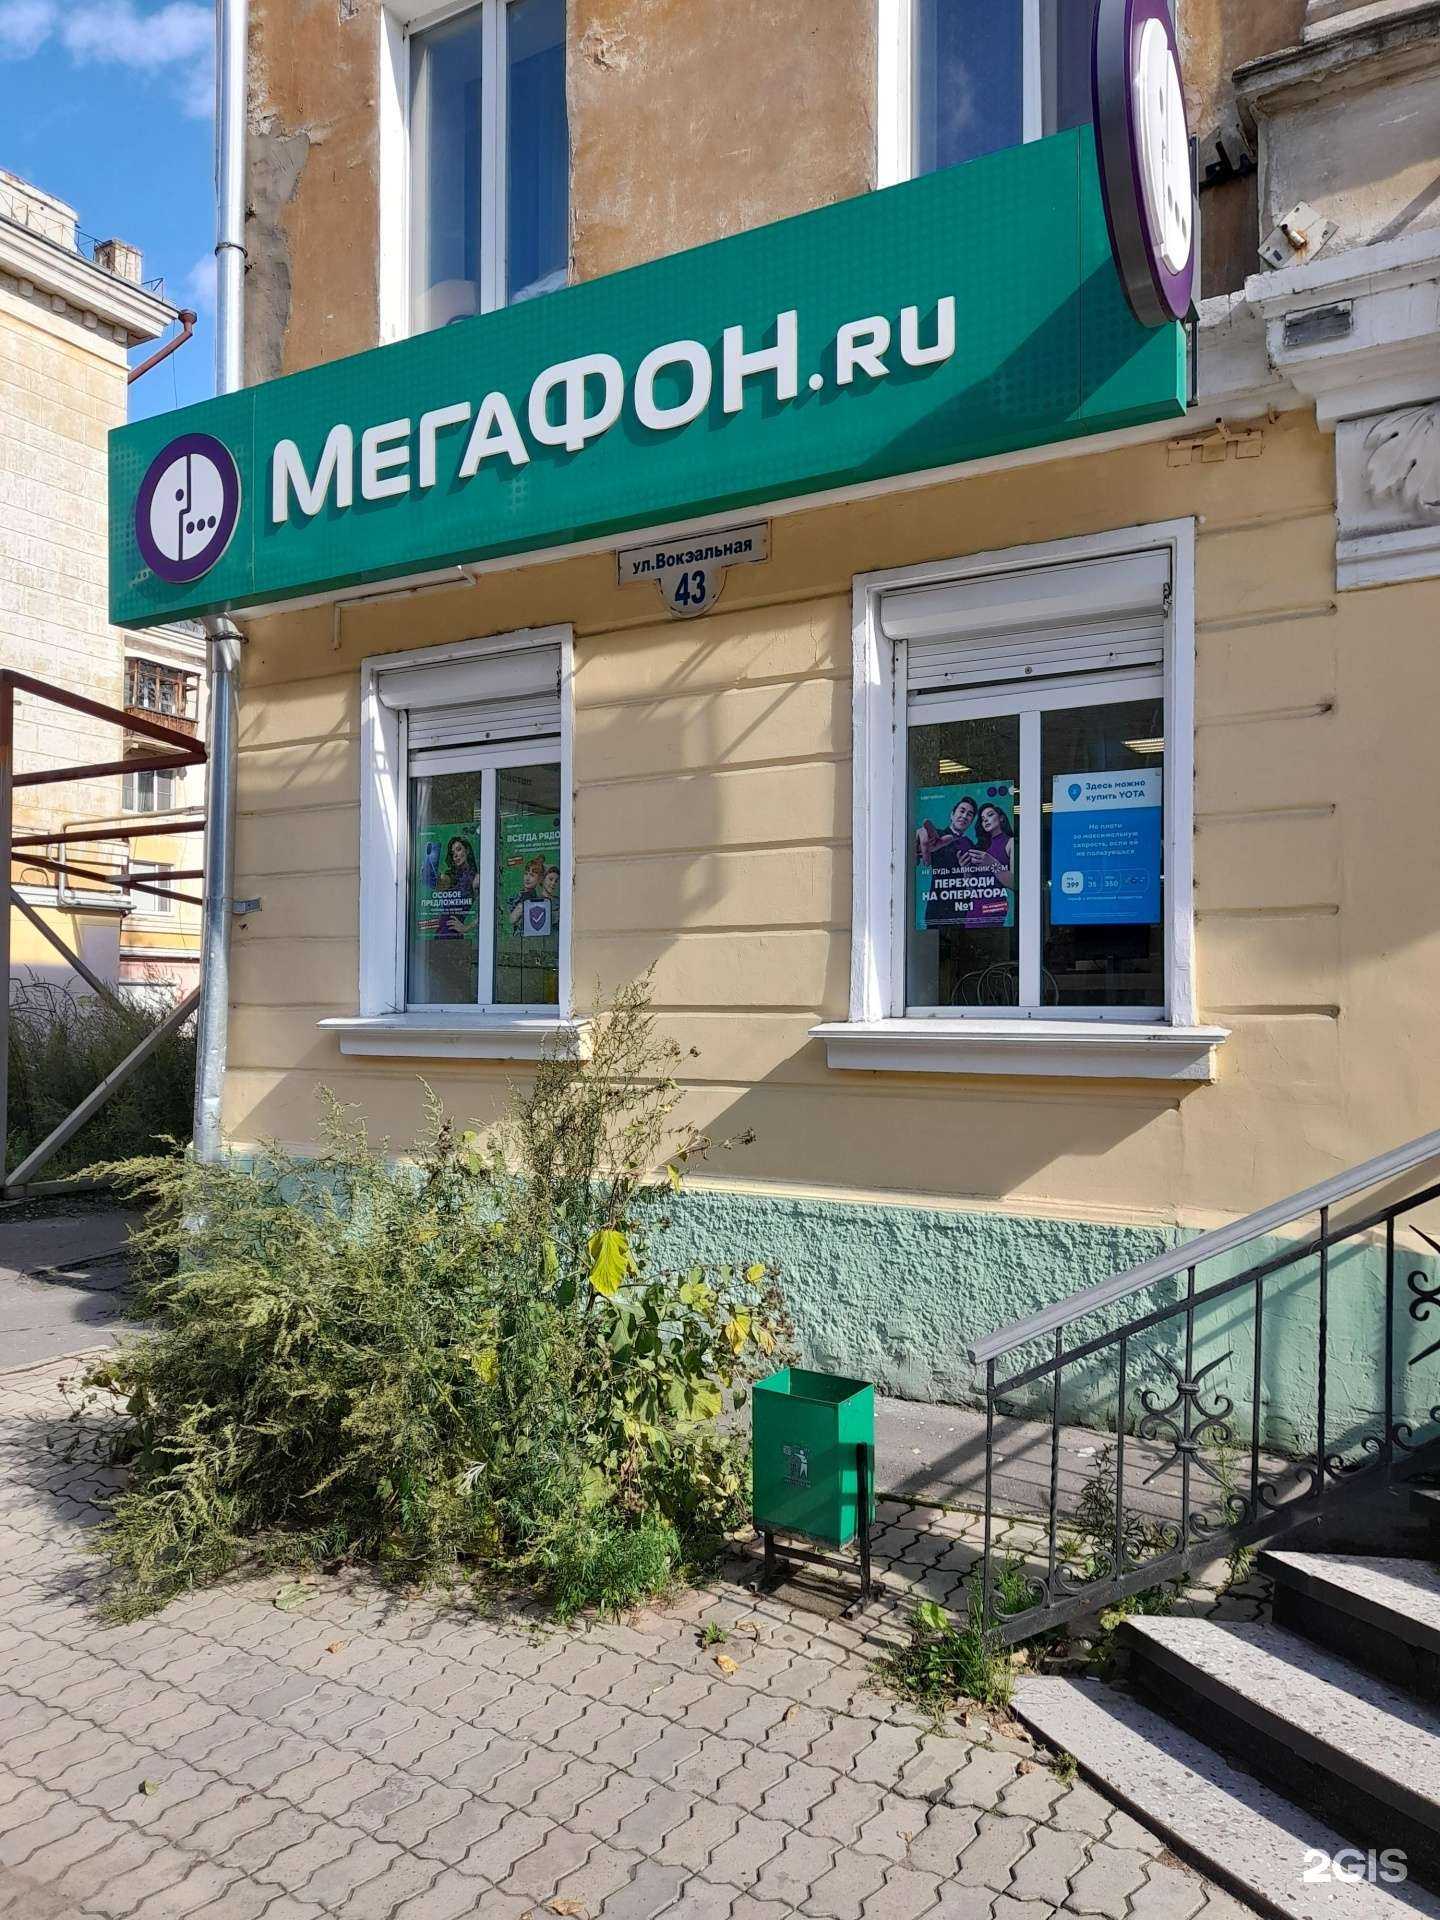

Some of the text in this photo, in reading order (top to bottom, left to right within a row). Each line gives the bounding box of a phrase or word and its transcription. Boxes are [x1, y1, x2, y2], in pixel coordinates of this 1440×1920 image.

[675, 570, 706, 606] 43
[1085, 780, 1146, 791] Здесь можно
[1086, 790, 1145, 803] купить YOTA
[507, 832, 538, 843] ВСЕГДА
[932, 867, 951, 876] БУДЬ
[934, 876, 995, 889] ПЕРЕХОДИ
[432, 890, 462, 899] ОСОБОЕ
[922, 888, 1009, 901] НА ОПЕРАТОРА
[421, 898, 473, 908] ПРЕДЛОЖЕНИЕ
[954, 901, 974, 912] №1
